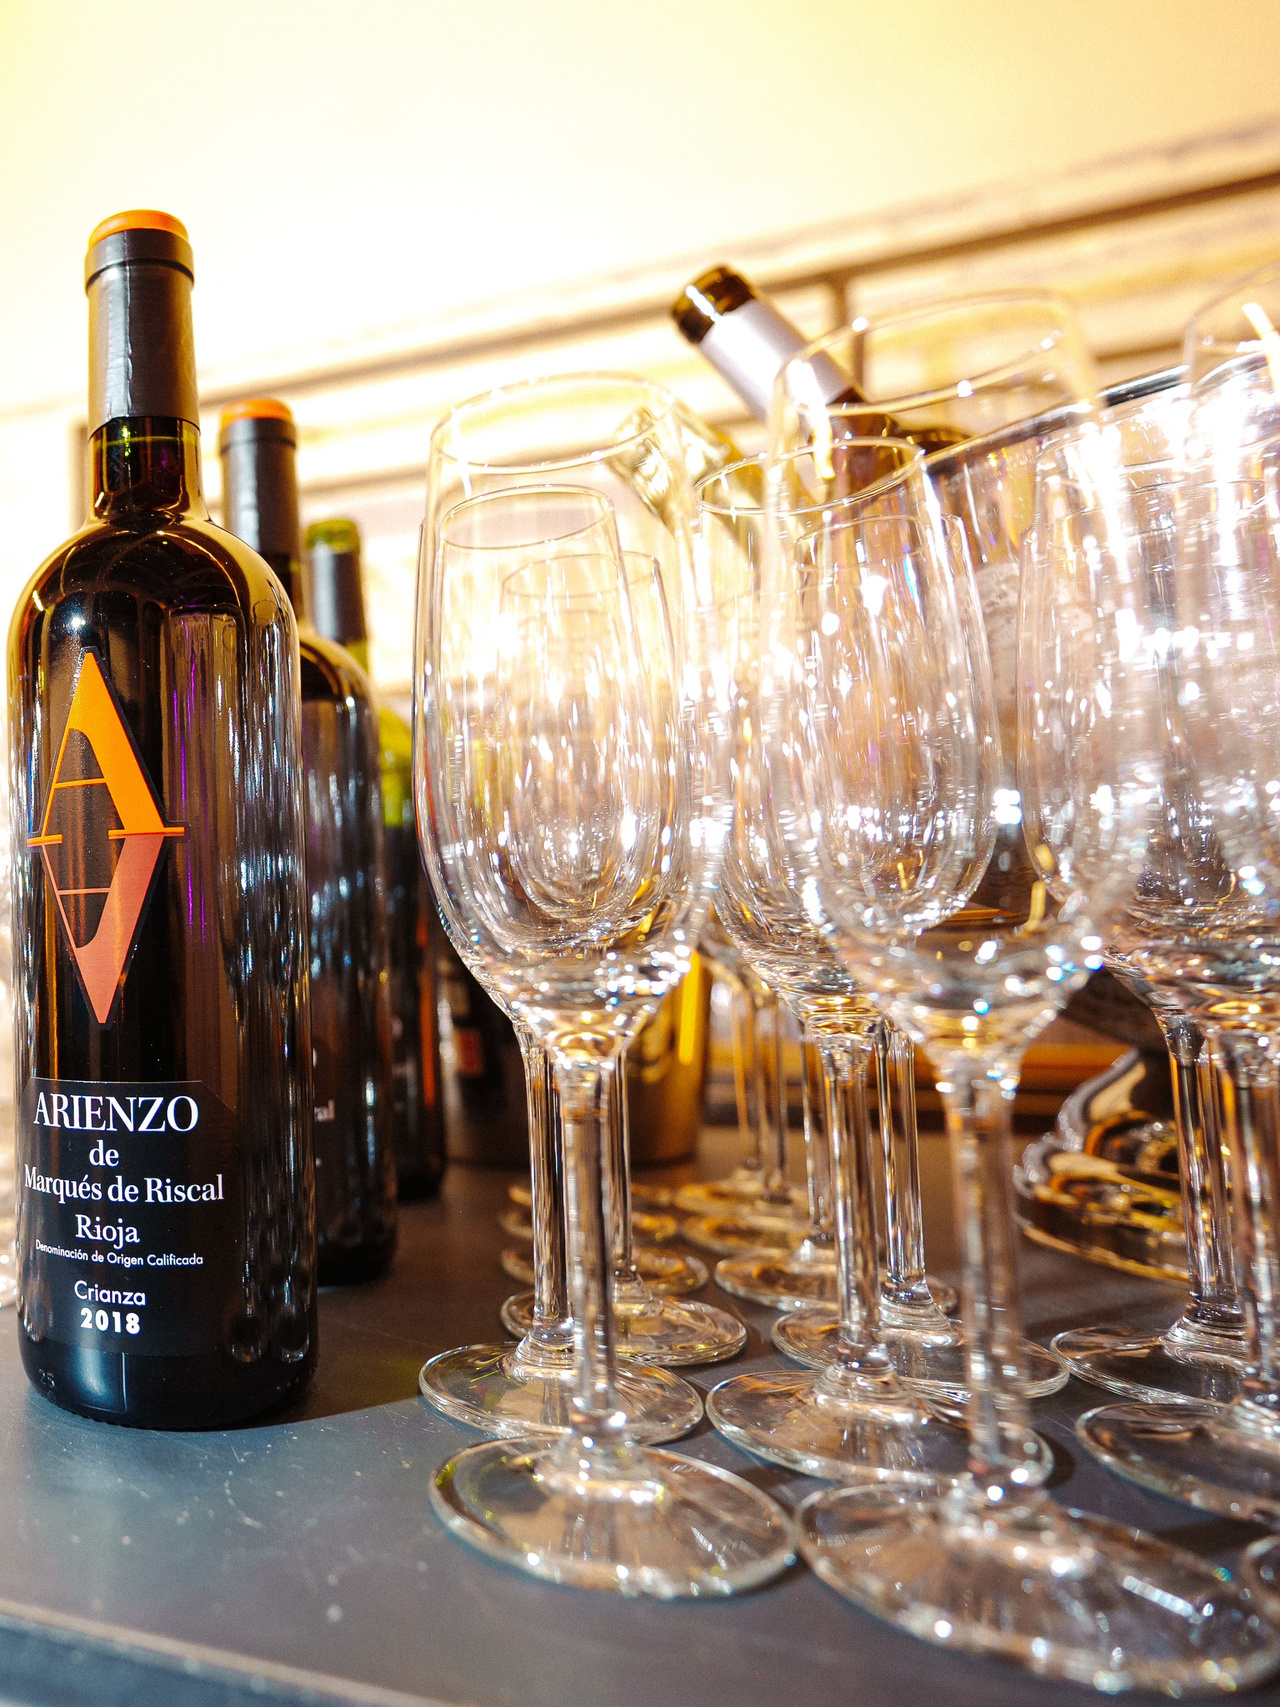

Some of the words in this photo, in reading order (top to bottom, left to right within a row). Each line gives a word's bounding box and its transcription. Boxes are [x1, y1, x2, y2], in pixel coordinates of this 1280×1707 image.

[33, 1091, 199, 1132] ARIENZO
[89, 1139, 120, 1167] de
[24, 1163, 103, 1204] Marqués
[107, 1175, 139, 1203] de
[144, 1173, 225, 1203] Riscal
[74, 1214, 141, 1249] Rioja
[35, 1238, 89, 1262] Denominación
[91, 1250, 105, 1263] de
[107, 1252, 144, 1268] Origen
[147, 1252, 204, 1267] Calificada
[74, 1280, 146, 1306] Crianza
[80, 1307, 141, 1335] 2018
